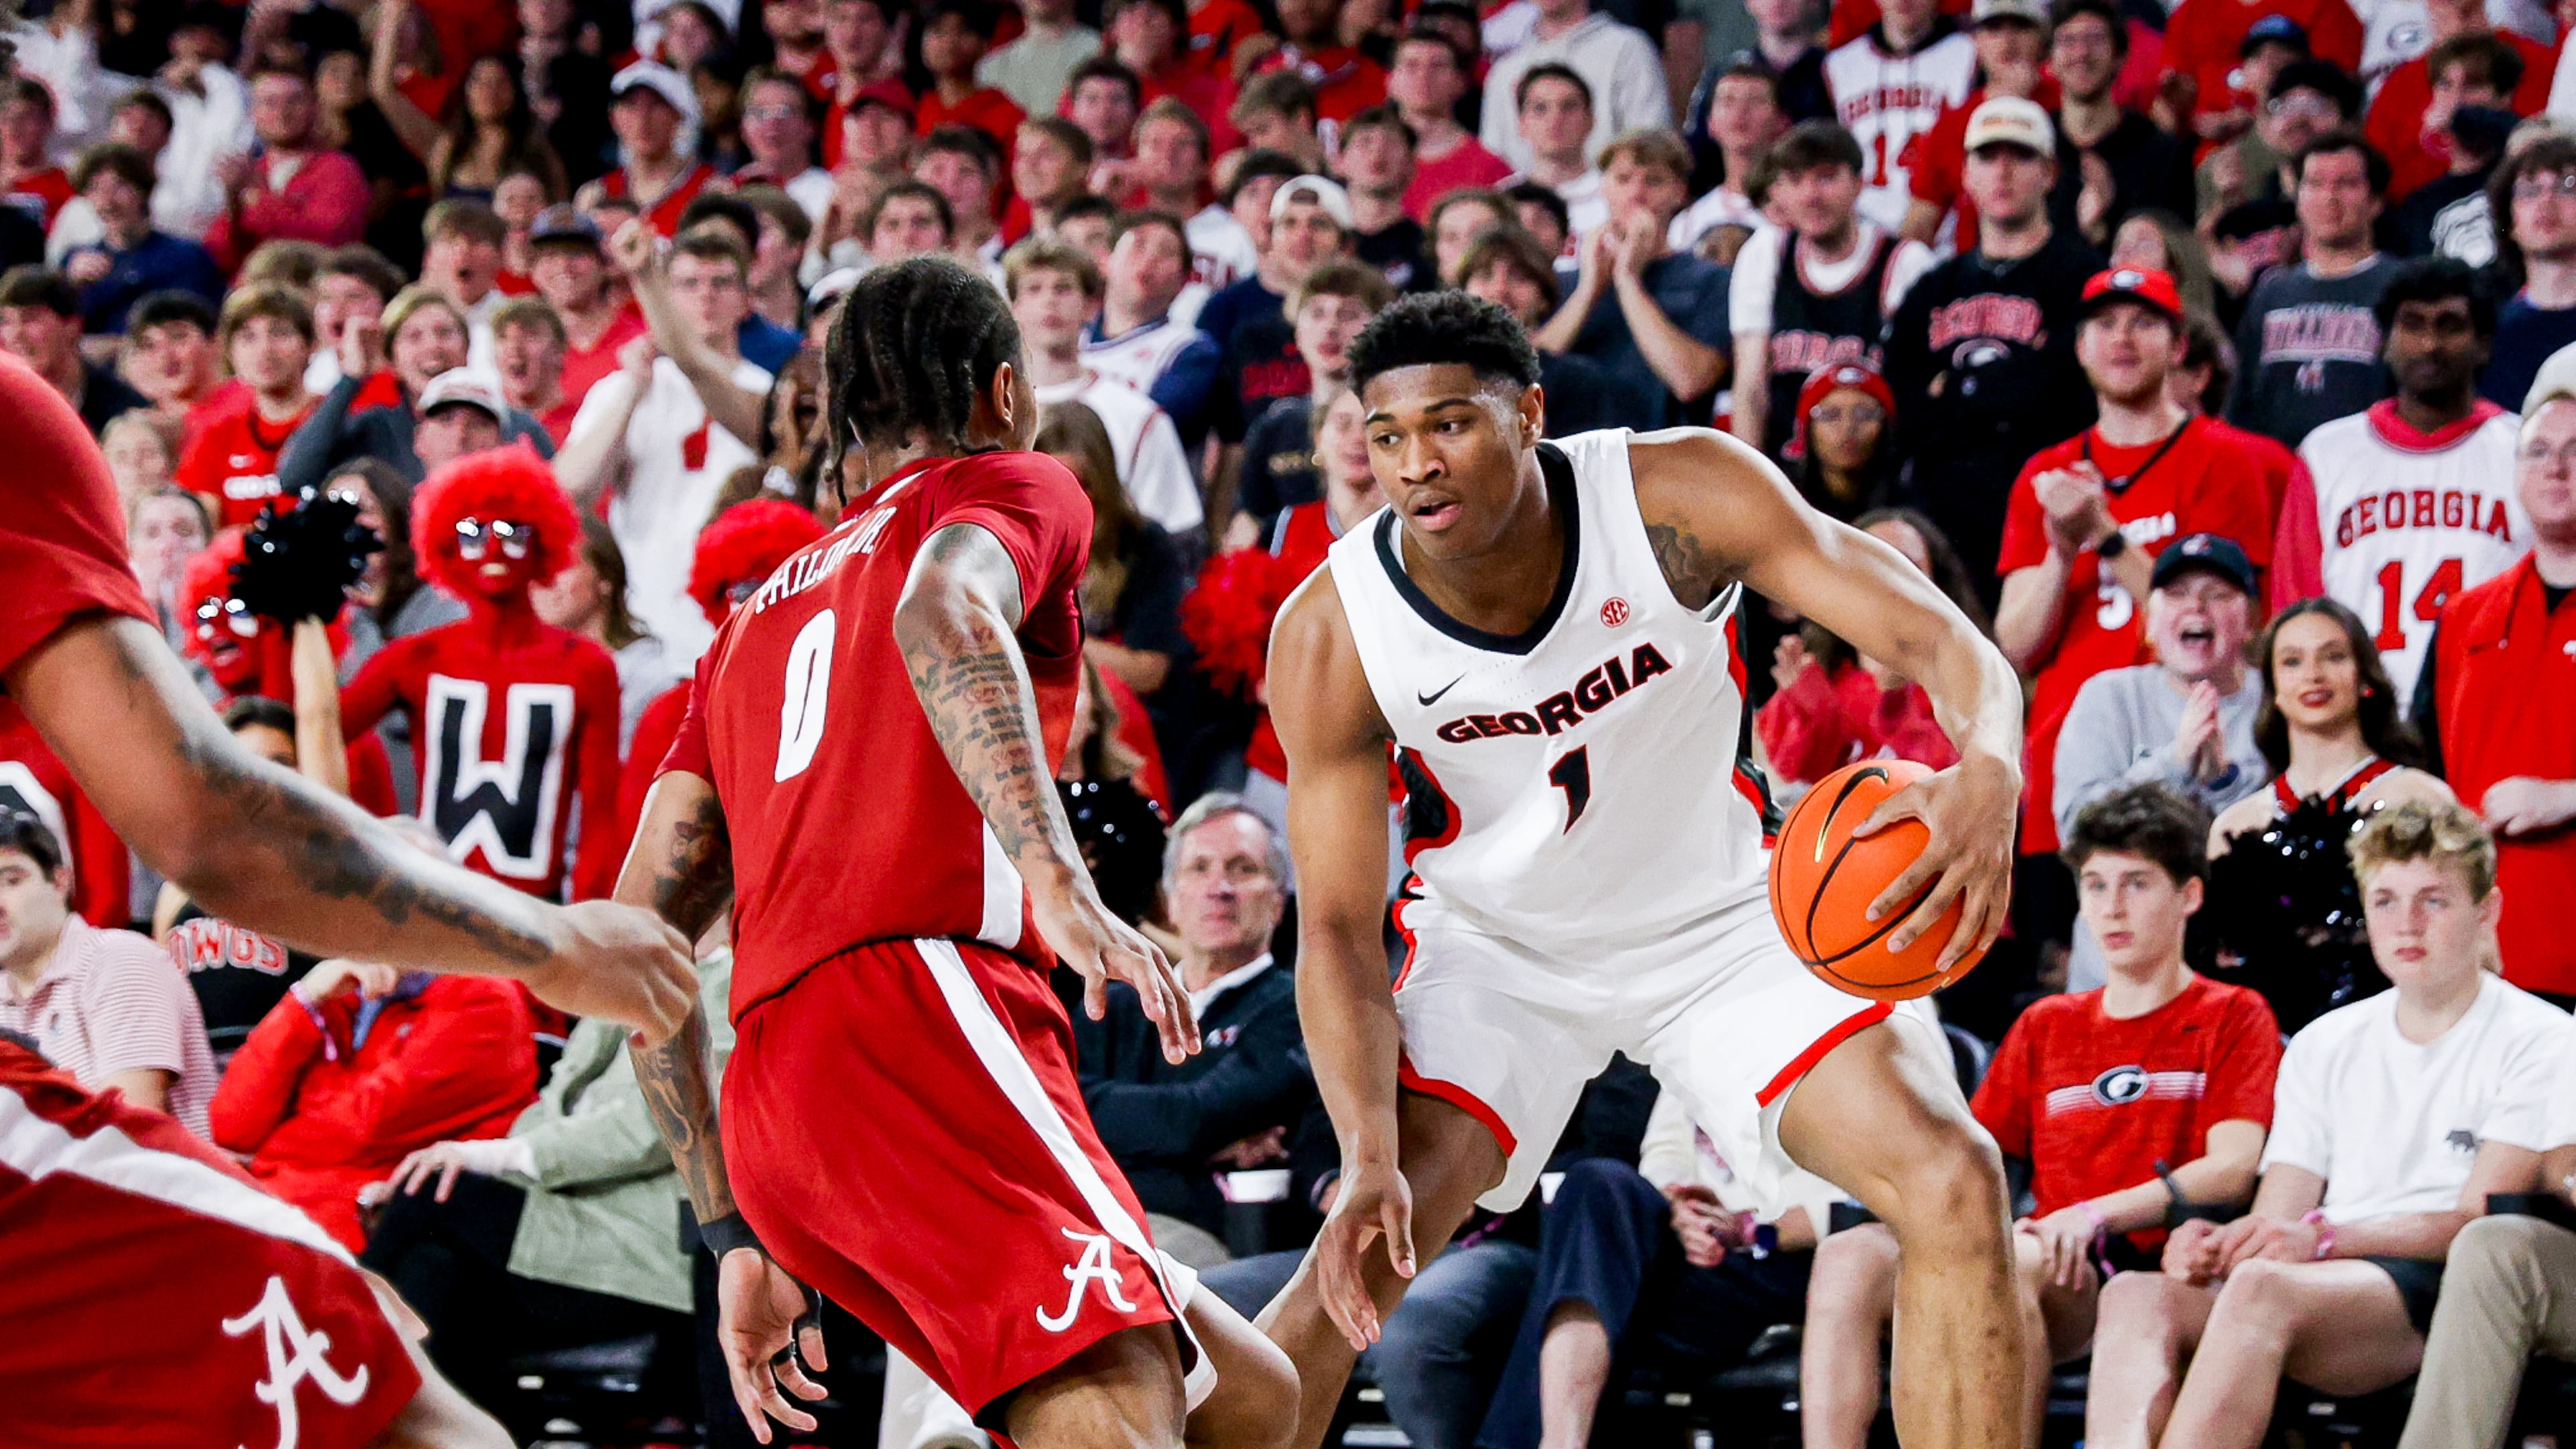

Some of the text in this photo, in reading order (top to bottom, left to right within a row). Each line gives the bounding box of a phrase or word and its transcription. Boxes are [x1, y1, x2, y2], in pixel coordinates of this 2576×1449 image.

[2337, 490, 2512, 549] GEORGIA
[1602, 598, 1628, 626] SEC
[775, 608, 836, 783] 0
[1437, 642, 1672, 743] GEORGIA
[421, 672, 575, 881] W
[1548, 744, 1591, 835] 1
